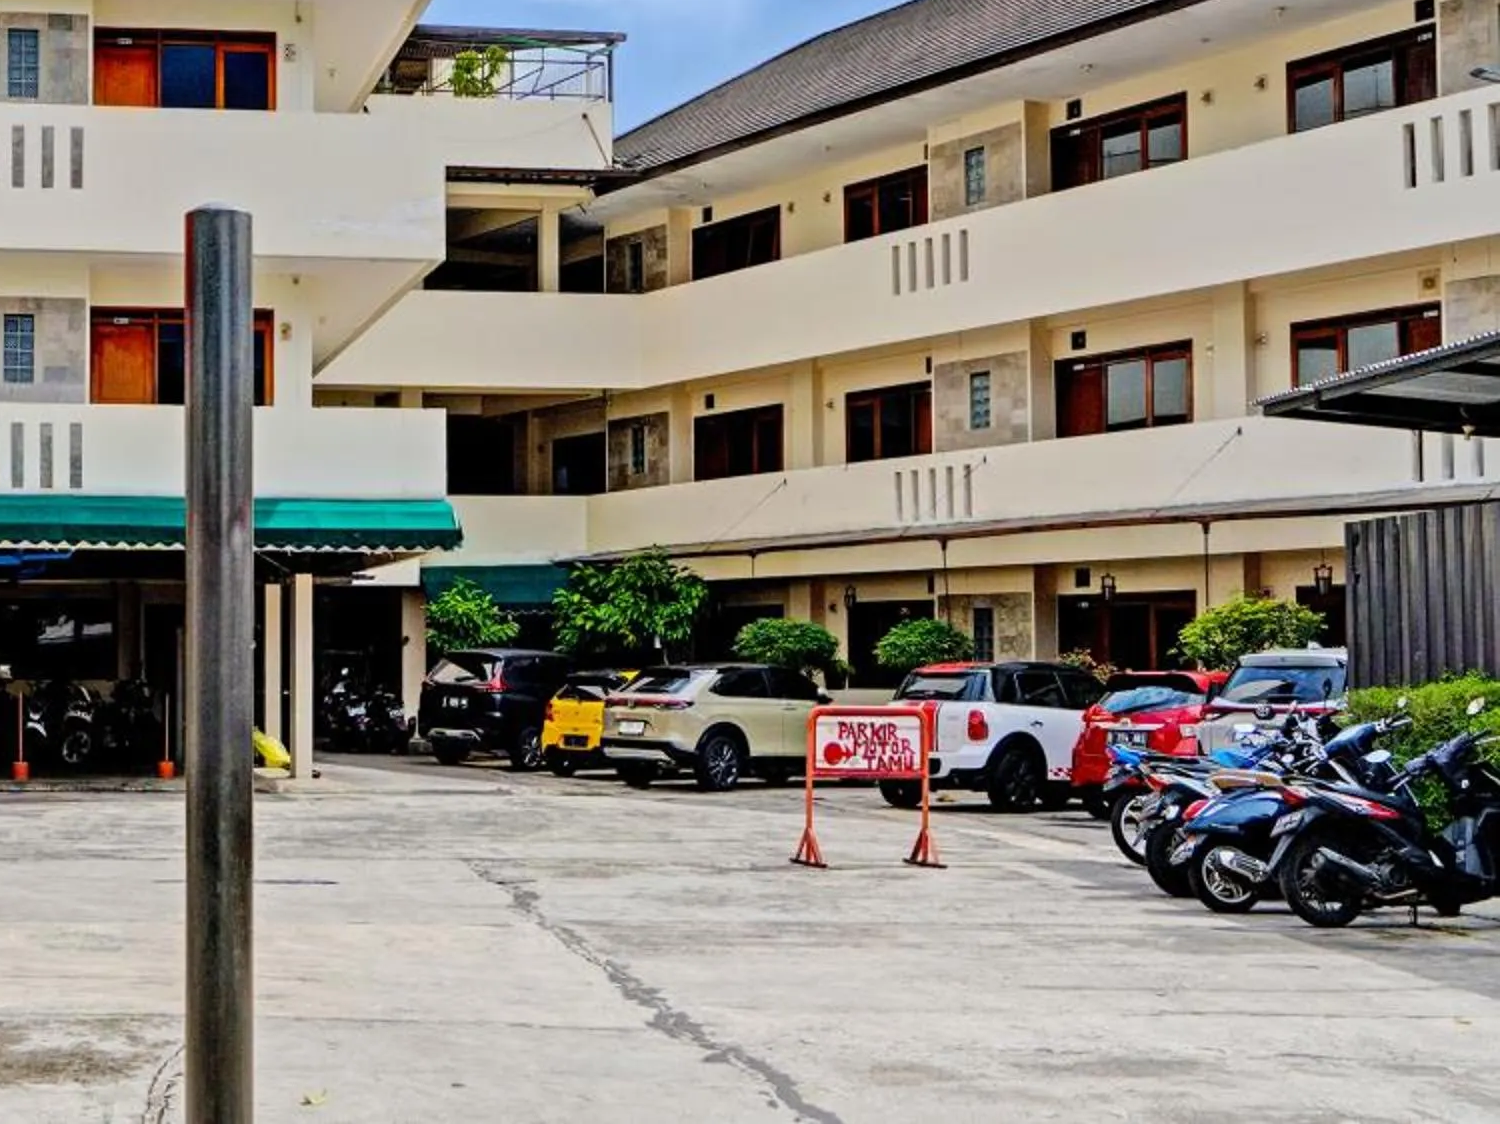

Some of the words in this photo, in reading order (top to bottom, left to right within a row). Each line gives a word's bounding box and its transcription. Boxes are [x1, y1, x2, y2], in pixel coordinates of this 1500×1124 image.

[838, 722, 898, 740] PARKIR
[853, 739, 915, 757] MOTOR
[862, 753, 915, 772] TAMU
